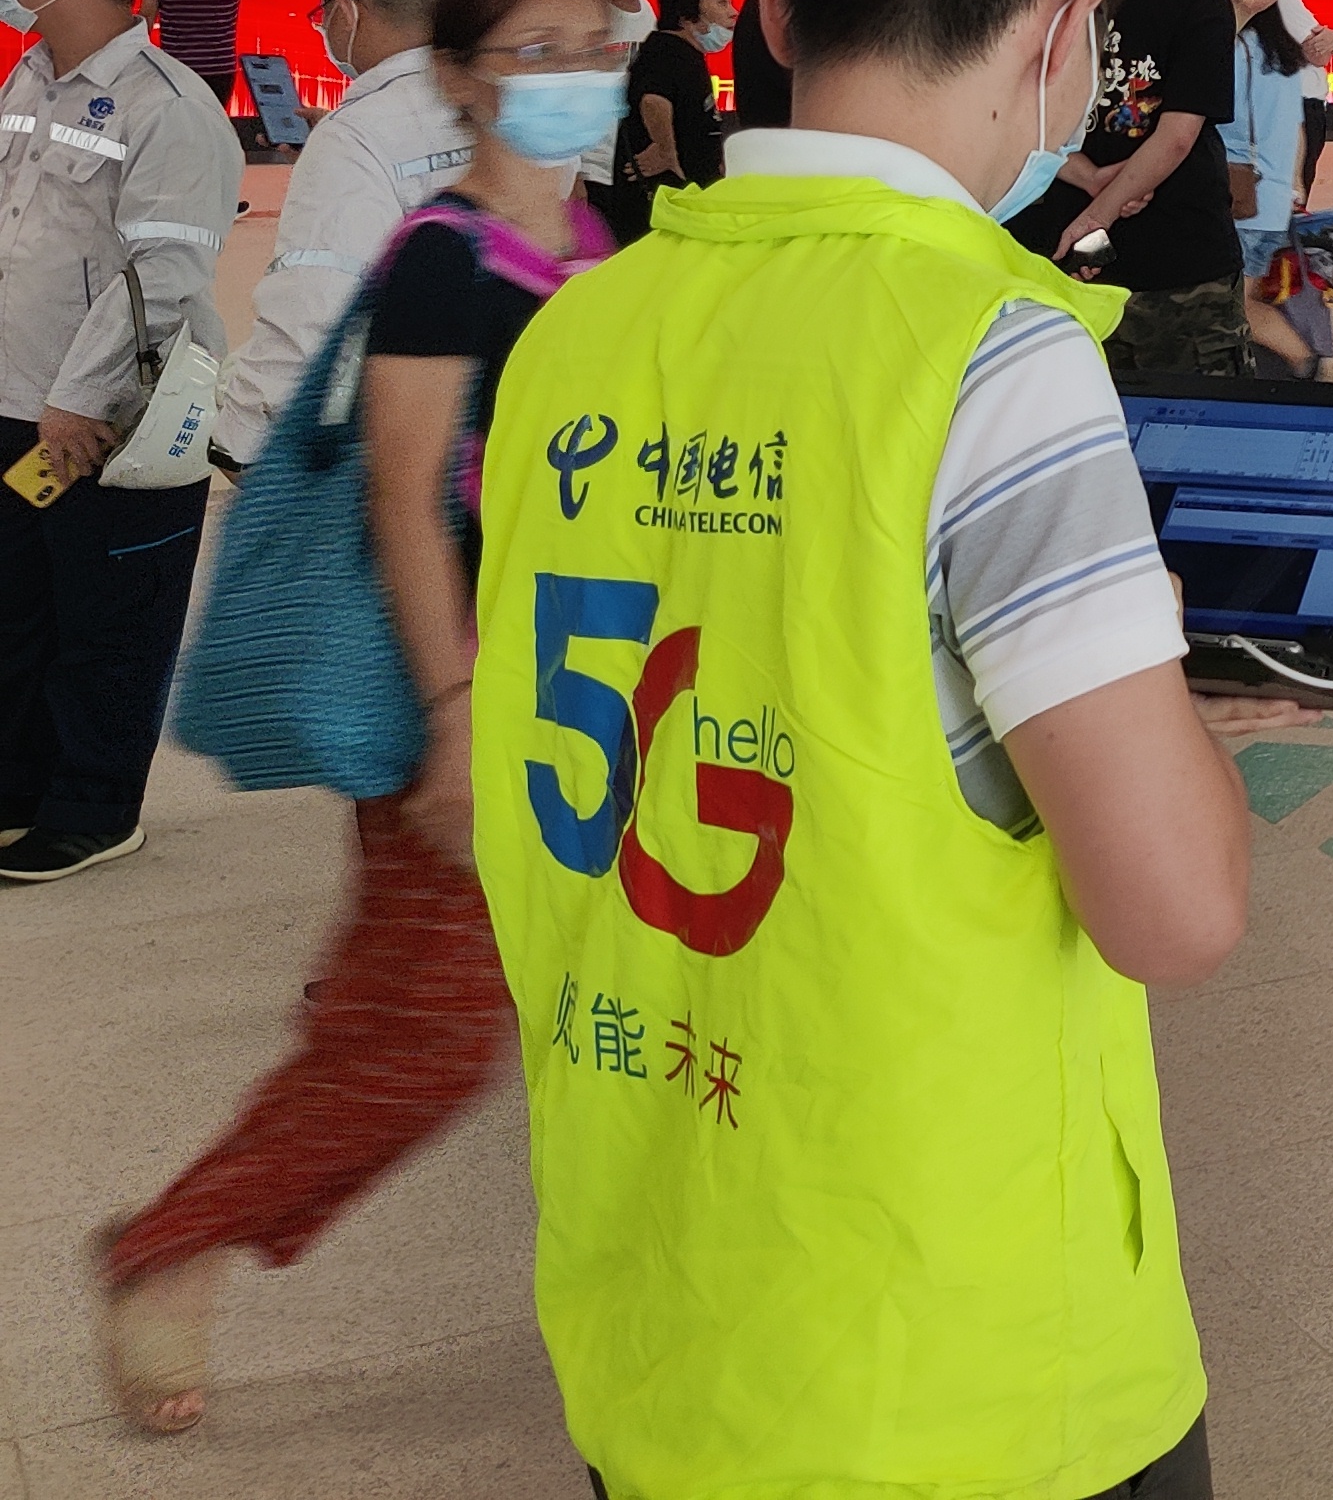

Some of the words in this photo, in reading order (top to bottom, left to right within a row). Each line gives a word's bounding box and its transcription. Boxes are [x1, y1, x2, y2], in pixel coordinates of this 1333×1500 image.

[636, 420, 789, 506] 中国电信
[524, 571, 794, 957] 5G
[693, 696, 795, 779] hello
